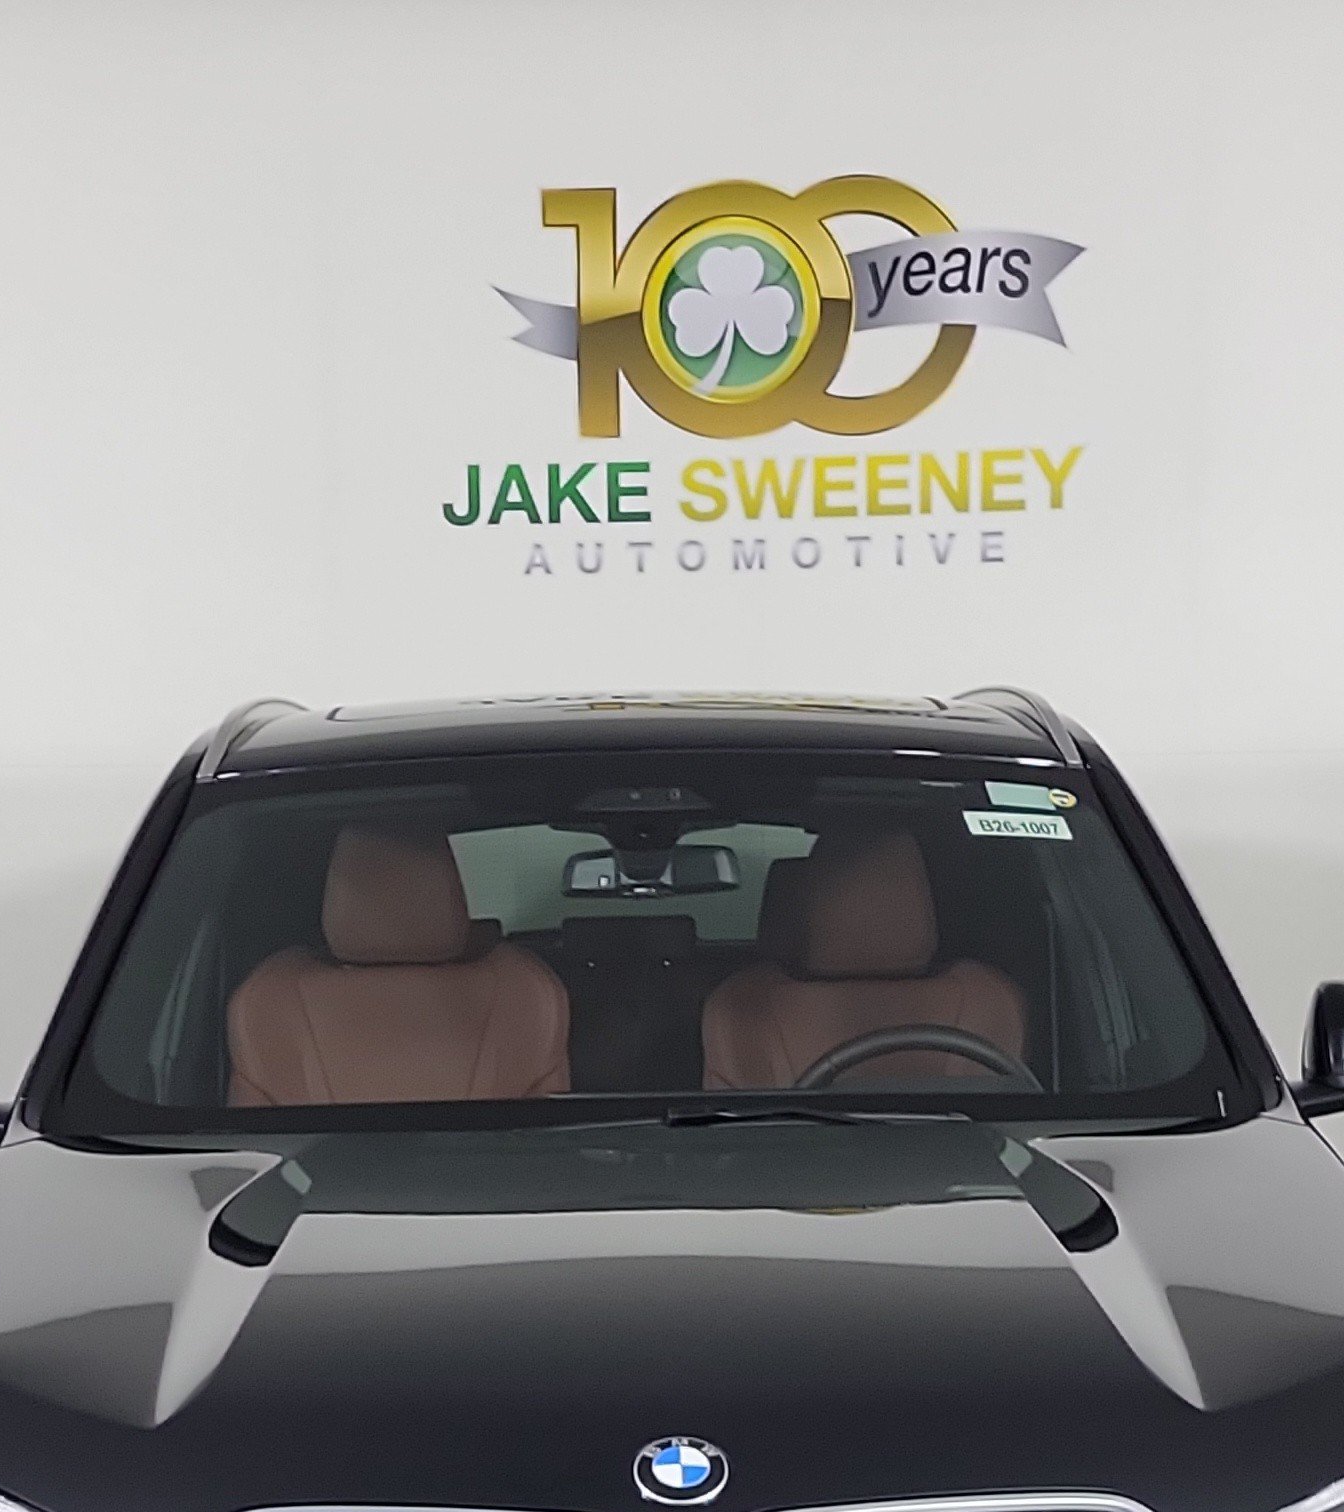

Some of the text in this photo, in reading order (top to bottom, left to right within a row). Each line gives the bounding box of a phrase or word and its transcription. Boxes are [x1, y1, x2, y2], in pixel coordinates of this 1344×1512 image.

[541, 173, 977, 439] 100
[865, 243, 1033, 320] years
[442, 446, 1084, 527] JAKE SWEENEY
[523, 530, 1009, 576] AUTOMOTIVE
[979, 819, 1058, 835] B26-1007
